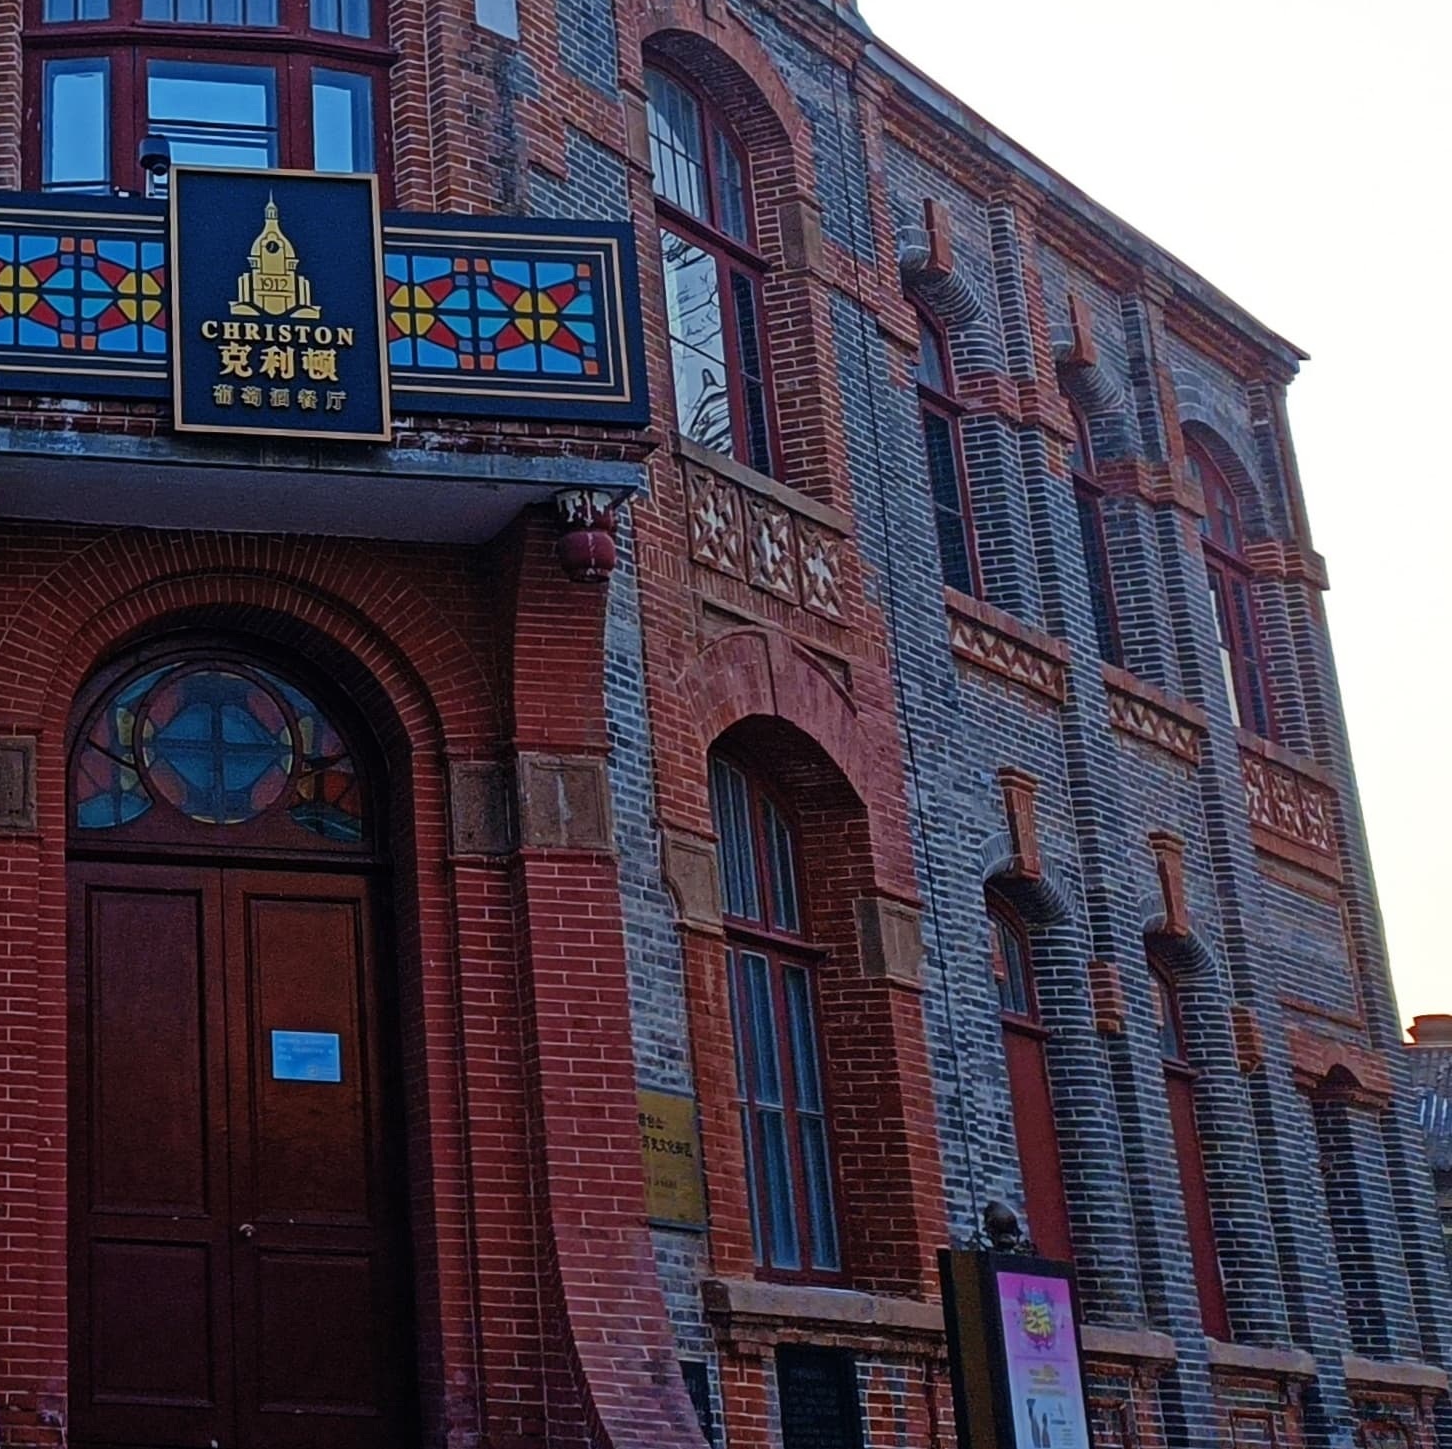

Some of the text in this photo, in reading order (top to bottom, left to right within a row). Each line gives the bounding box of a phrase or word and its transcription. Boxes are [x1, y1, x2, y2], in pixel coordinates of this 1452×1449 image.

[259, 277, 289, 292] 1912
[201, 320, 354, 346] CHRISTON
[218, 341, 339, 382] 克利顿
[213, 384, 347, 411] 葡萄酒餐厅
